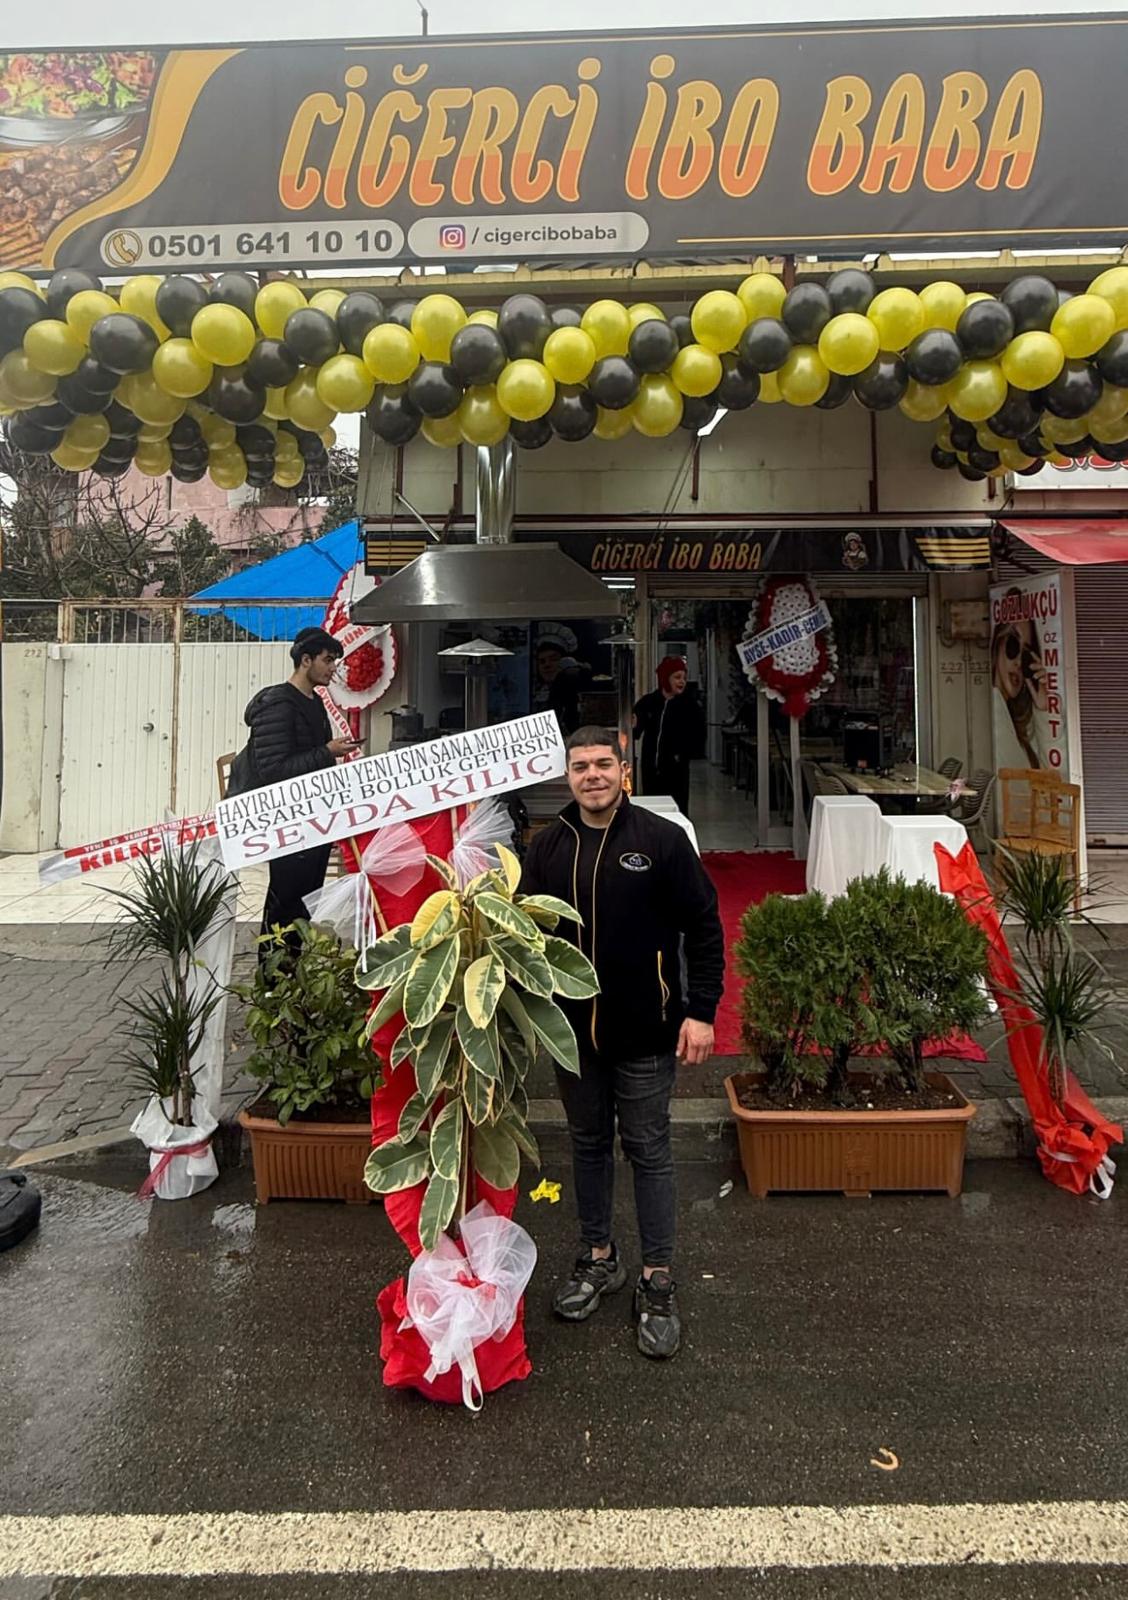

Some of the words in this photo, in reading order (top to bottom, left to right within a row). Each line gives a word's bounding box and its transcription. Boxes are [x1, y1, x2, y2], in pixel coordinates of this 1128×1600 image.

[279, 57, 601, 210] CİĞERCİ
[625, 55, 780, 199] İBO
[807, 69, 1043, 195] BABA
[148, 233, 221, 257] 0501
[236, 231, 290, 255] 641
[306, 230, 343, 254] 10
[355, 229, 392, 253] 10
[484, 226, 617, 245] cigercibobaba
[591, 537, 664, 570] CİĞERCİ
[668, 537, 703, 570] İBO
[709, 542, 762, 570] BABA
[218, 786, 286, 825] HAYIRLI
[290, 769, 351, 803] OLSUN!
[430, 735, 473, 768] SANA
[474, 714, 556, 753] MUTLULUK
[223, 801, 314, 839] BAŞARI
[320, 789, 353, 809] VE
[360, 762, 458, 799] BOLLUK
[242, 793, 416, 858] SEVDA
[427, 753, 552, 804] KILIÇ
